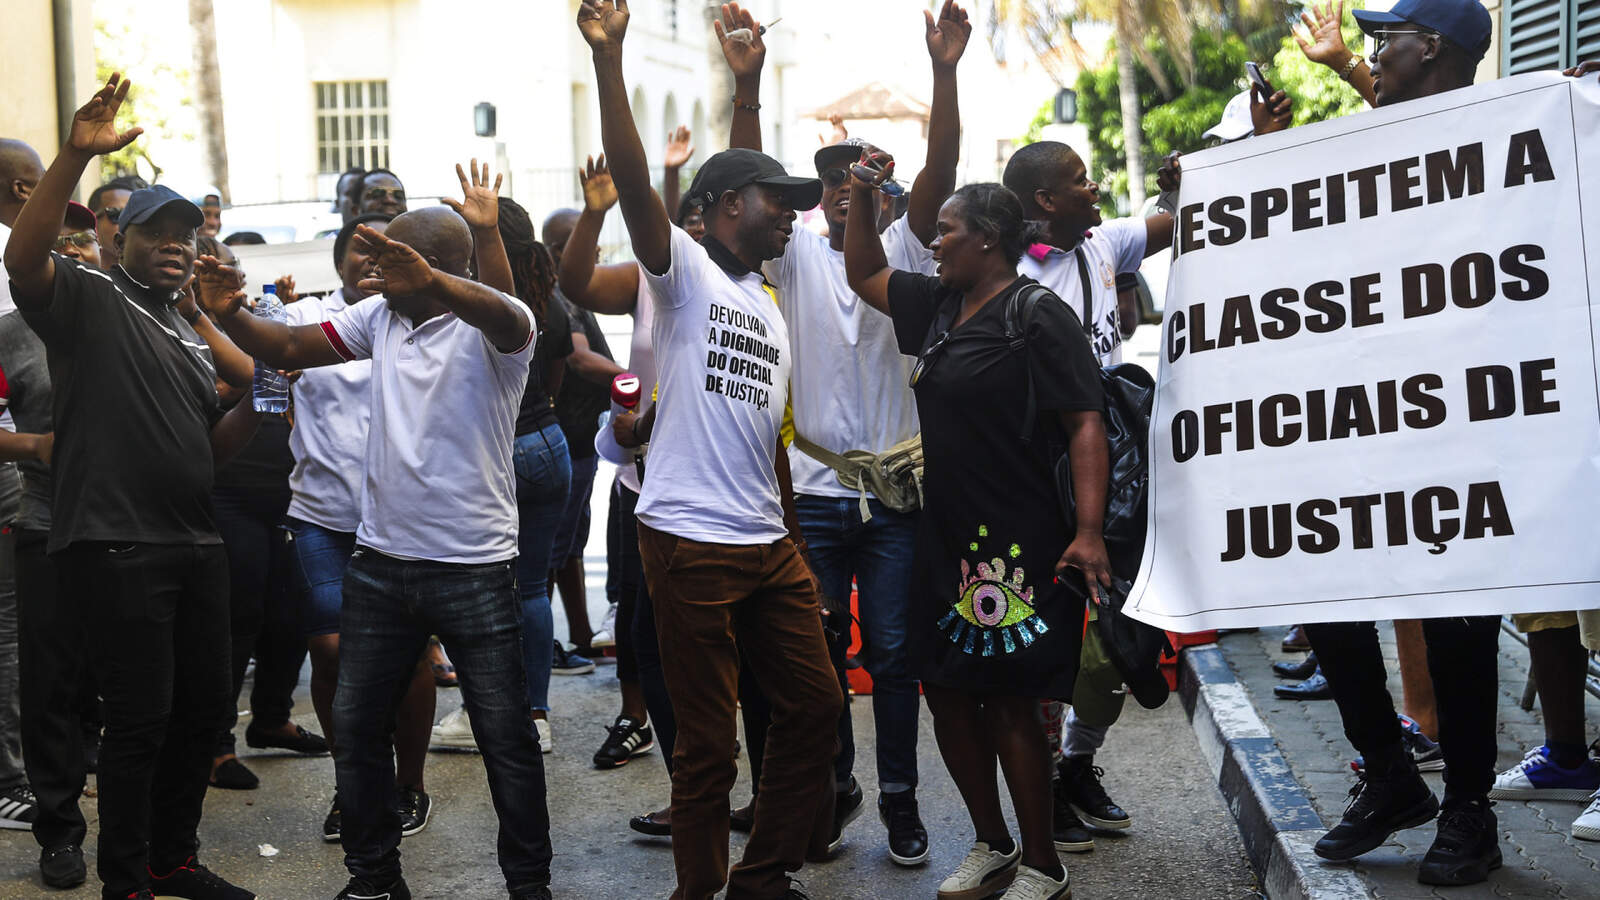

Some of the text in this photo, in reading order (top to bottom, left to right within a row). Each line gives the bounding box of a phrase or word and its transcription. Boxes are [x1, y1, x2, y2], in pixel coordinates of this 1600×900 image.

[1503, 128, 1556, 189] A
[709, 303, 768, 338] DEVOLVAM
[1167, 272, 1384, 364] CLASSE
[1401, 243, 1550, 320] DOS
[706, 350, 773, 387] DO OFICIAL
[707, 326, 780, 366] A DIGNIDADE
[705, 373, 769, 411] DE JUSTIÇA
[1170, 357, 1561, 464] OFICIAIS DE
[1220, 480, 1515, 563] JUSTIÇA
